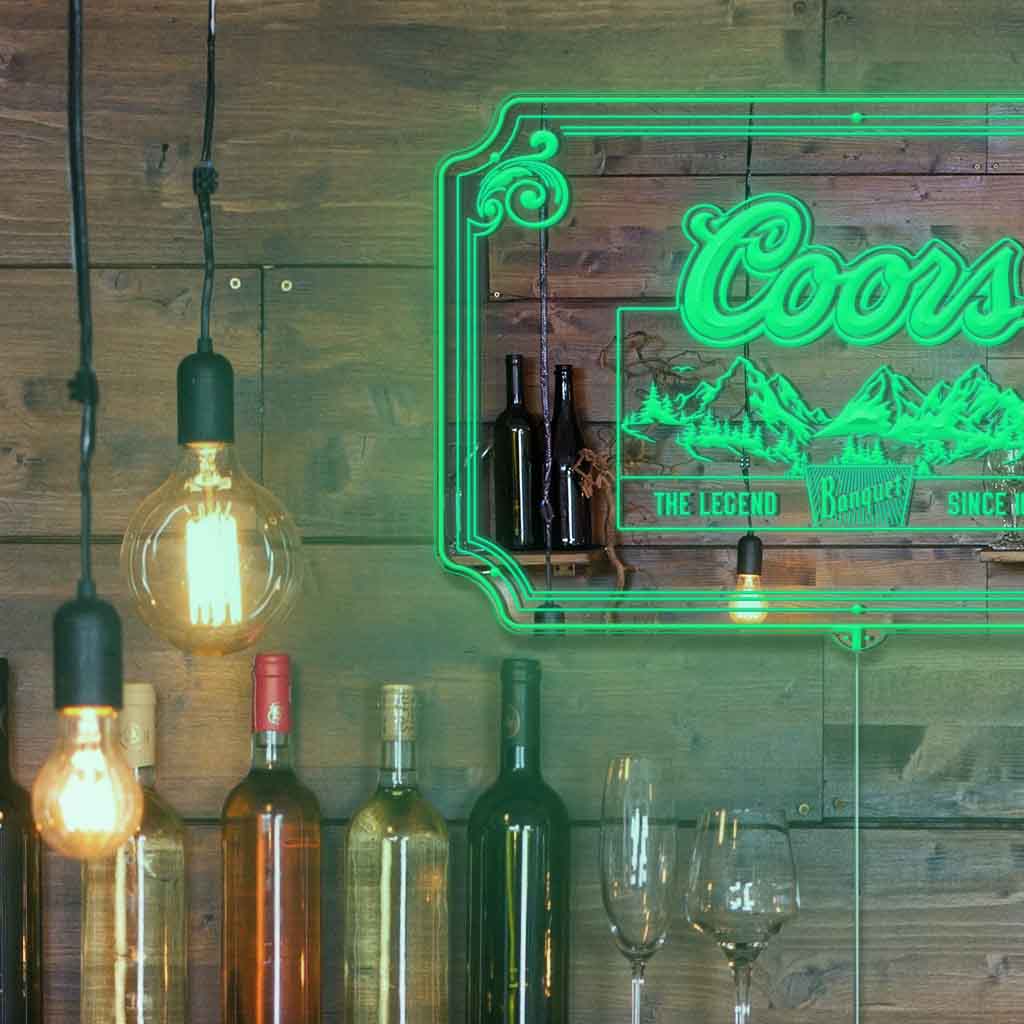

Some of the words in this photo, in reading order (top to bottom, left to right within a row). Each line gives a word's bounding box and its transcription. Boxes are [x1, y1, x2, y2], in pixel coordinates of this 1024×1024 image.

[654, 491, 691, 516] THE
[699, 491, 778, 516] LEGEND
[821, 474, 900, 519] Banquet
[947, 491, 1007, 516] SINCE
